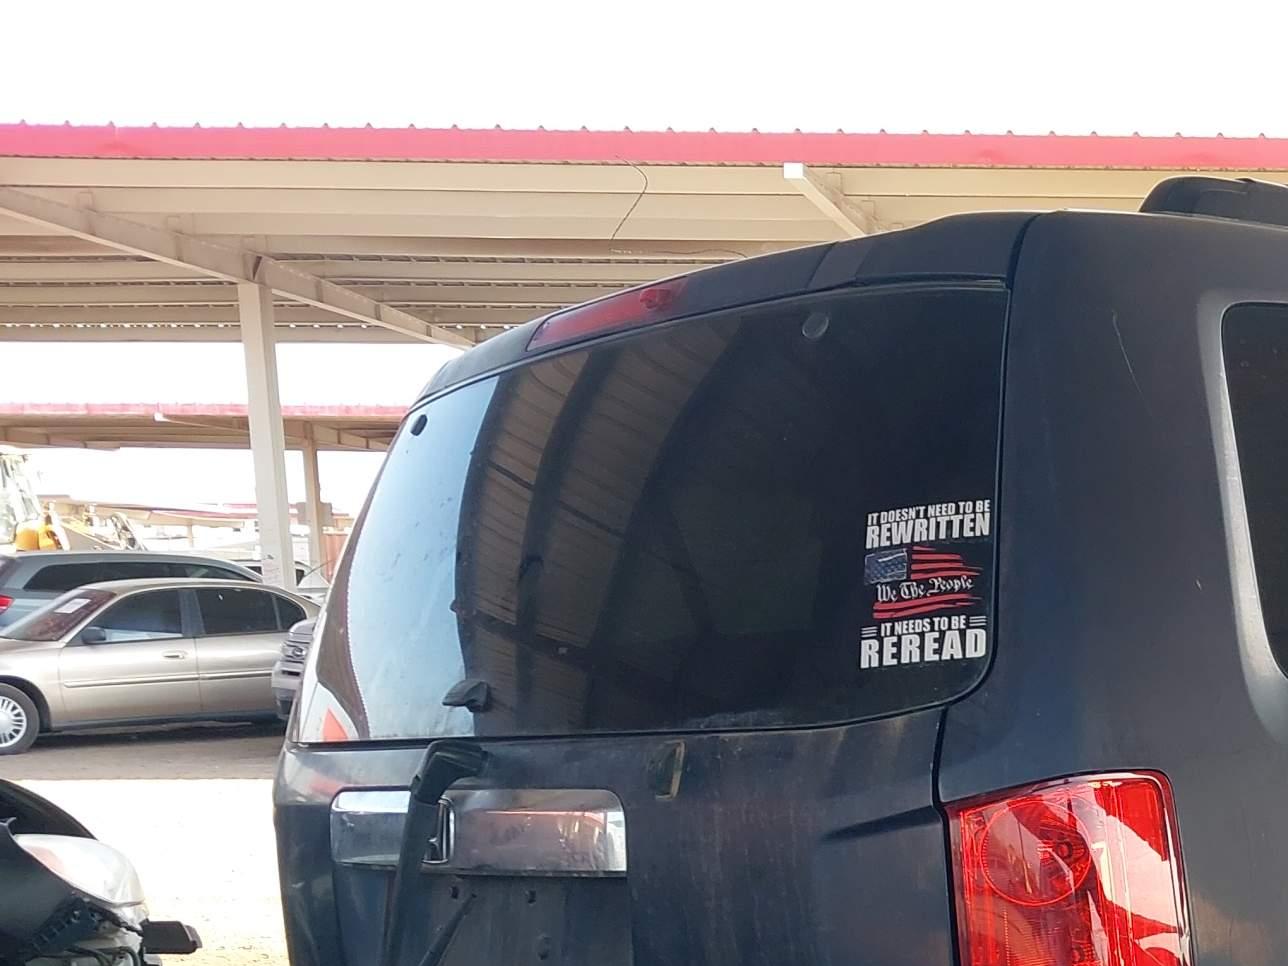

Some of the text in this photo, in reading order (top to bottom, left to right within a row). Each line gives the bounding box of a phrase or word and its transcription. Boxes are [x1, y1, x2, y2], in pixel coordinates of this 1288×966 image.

[867, 499, 991, 526] IT DOESN'T NEED TO BE
[865, 512, 991, 549] REWRITTEN
[877, 574, 974, 603] We The People
[880, 614, 967, 637] IT NEEDS TO BE
[860, 628, 987, 669] REREAD
